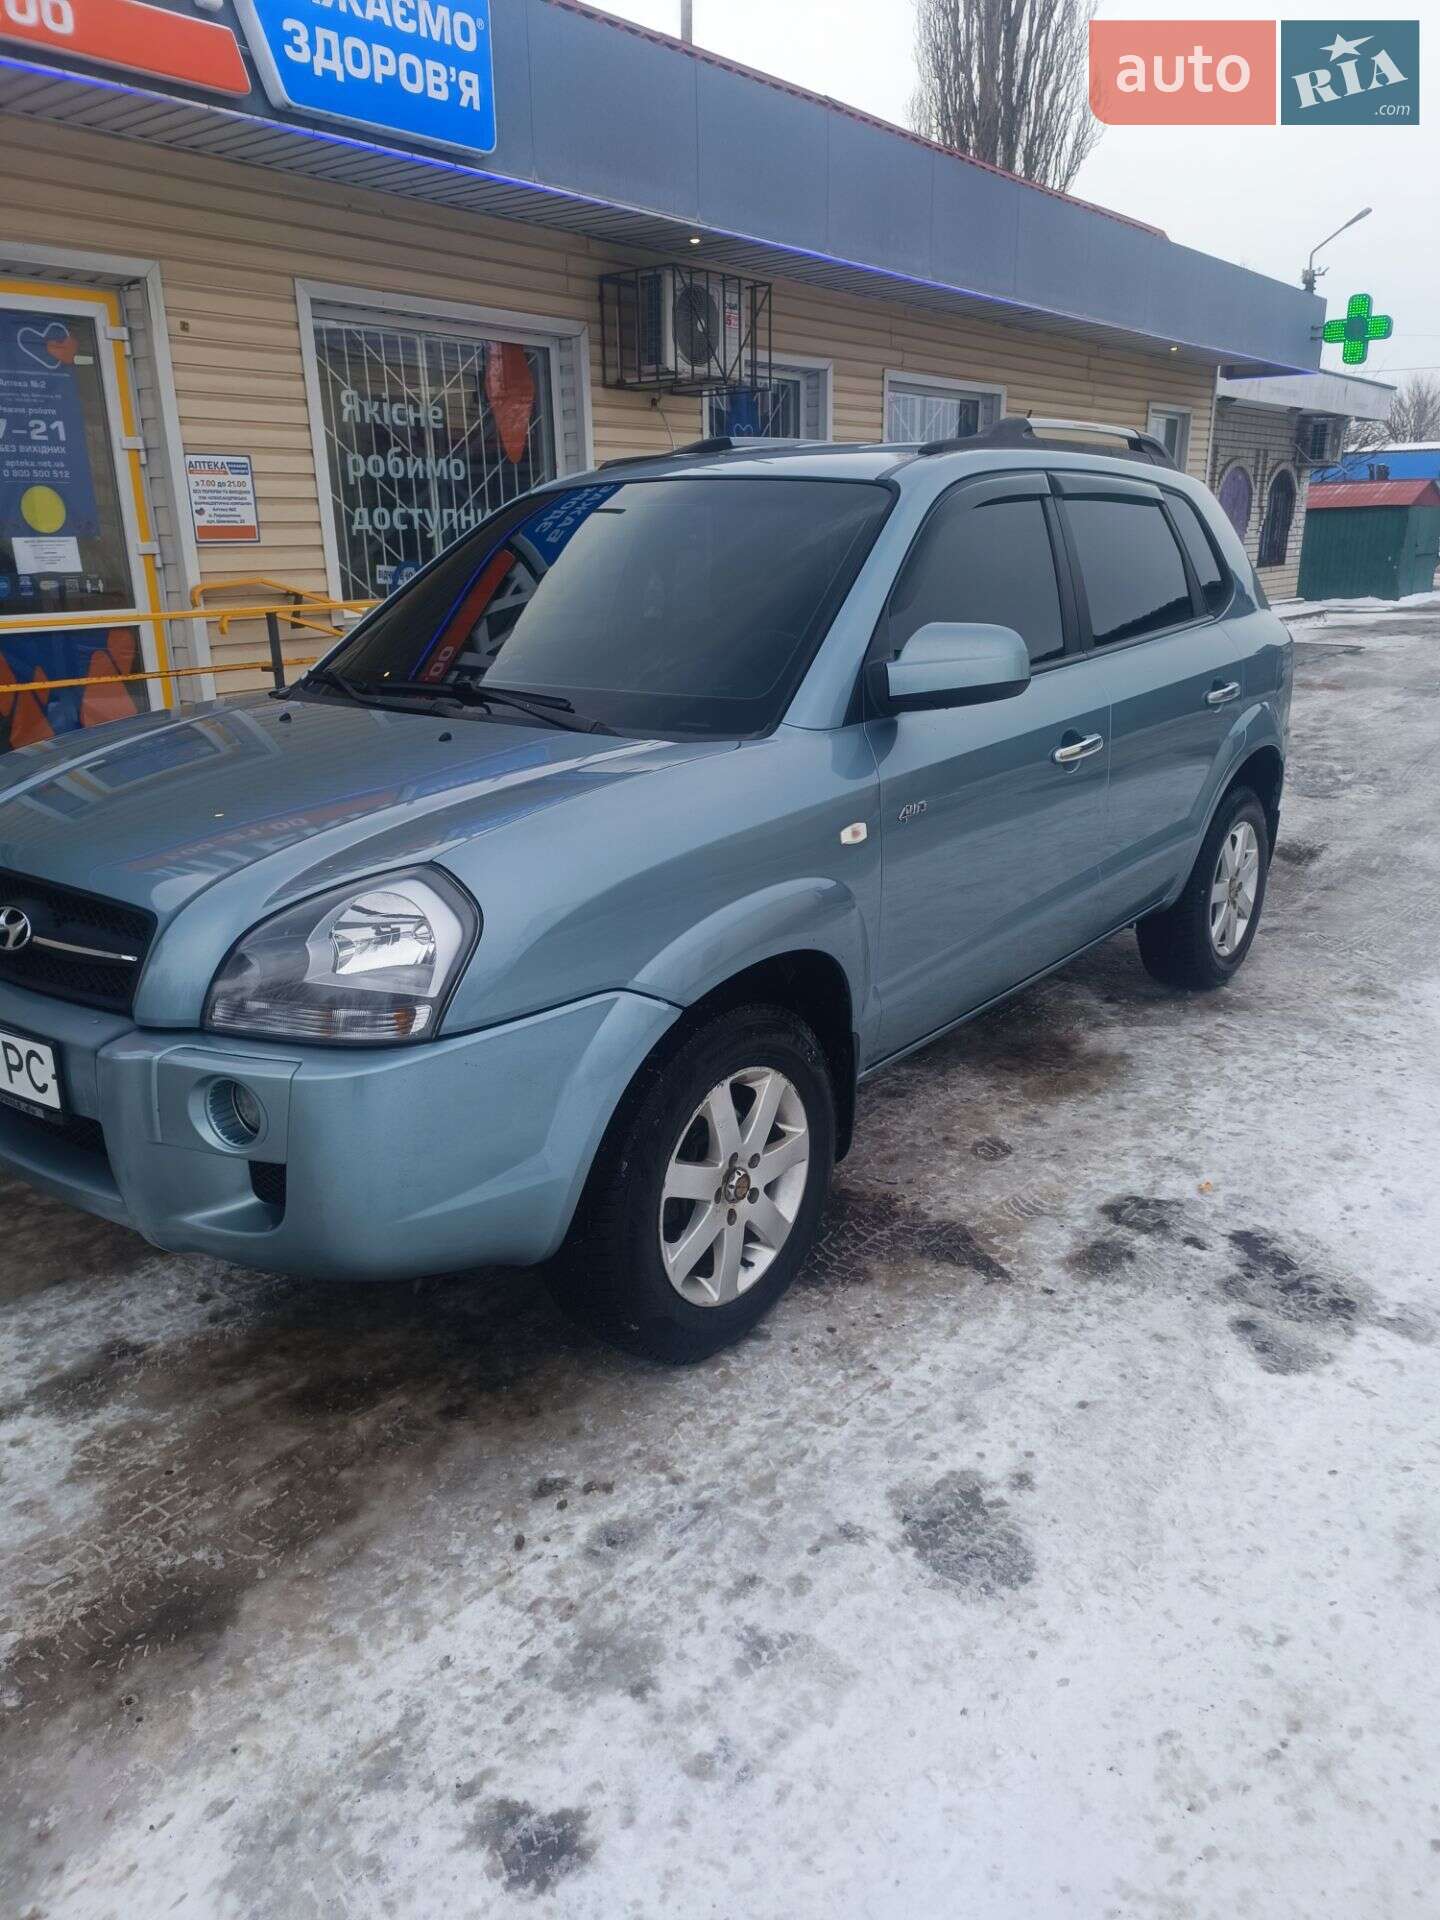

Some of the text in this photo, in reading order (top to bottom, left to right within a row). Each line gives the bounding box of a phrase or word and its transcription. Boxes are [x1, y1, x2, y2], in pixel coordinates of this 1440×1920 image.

[282, 18, 481, 111] ЗДОРОВ'Я
[340, 389, 444, 429] Якісне
[188, 460, 226, 470] АПТЕКА
[347, 447, 466, 485] робимо
